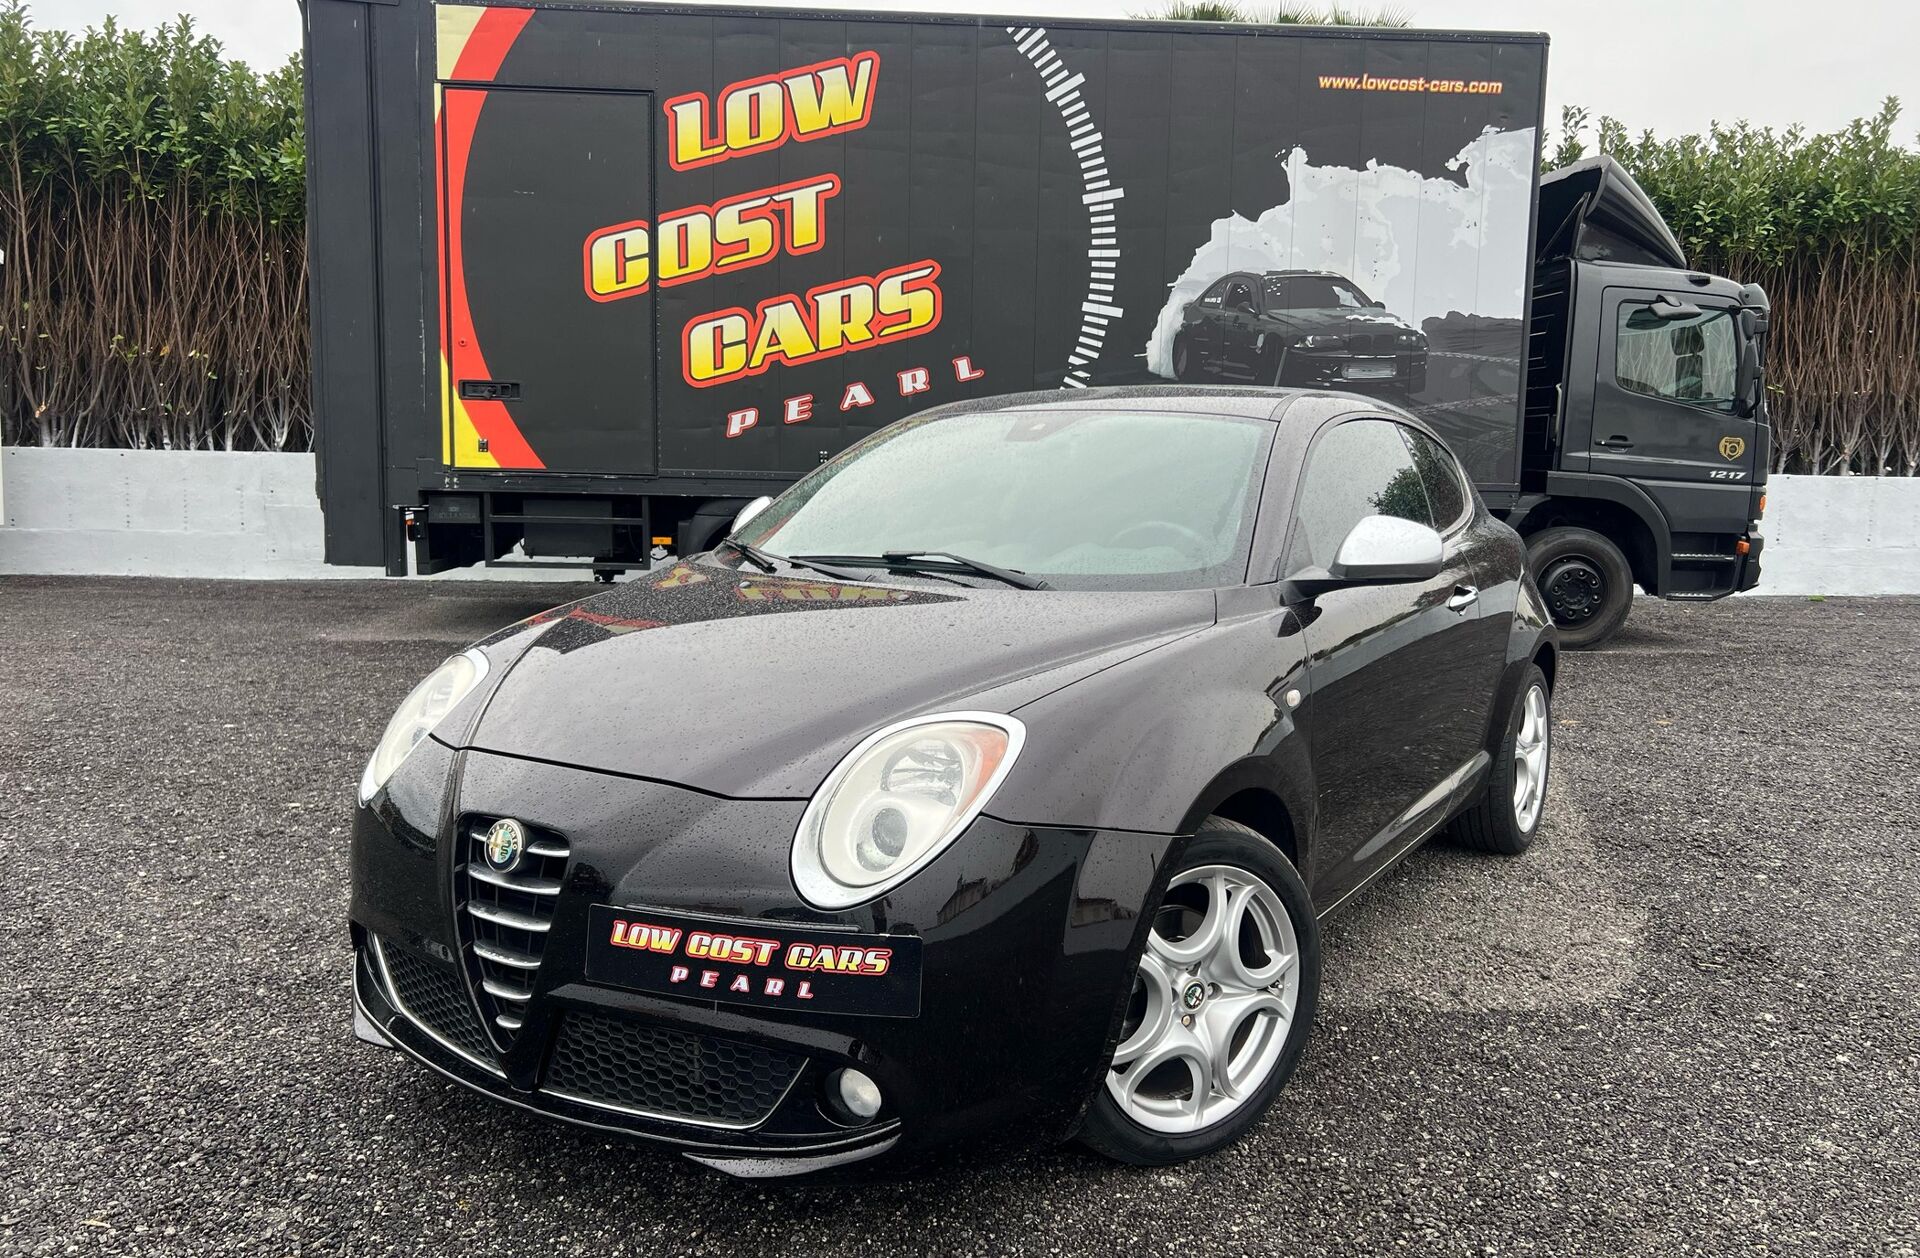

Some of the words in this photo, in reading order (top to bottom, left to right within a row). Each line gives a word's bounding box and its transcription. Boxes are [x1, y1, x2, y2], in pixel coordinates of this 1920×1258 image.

[668, 54, 877, 168] LOW
[1318, 73, 1503, 95] www.lowcost-cars.com
[587, 176, 837, 300] COST
[685, 262, 938, 385] CARS
[726, 356, 984, 438] PEARL
[1709, 470, 1747, 480] 1217
[609, 920, 682, 954] LOW
[687, 931, 780, 966] COST
[785, 943, 892, 975] CARS
[670, 965, 814, 1000] PEARL
